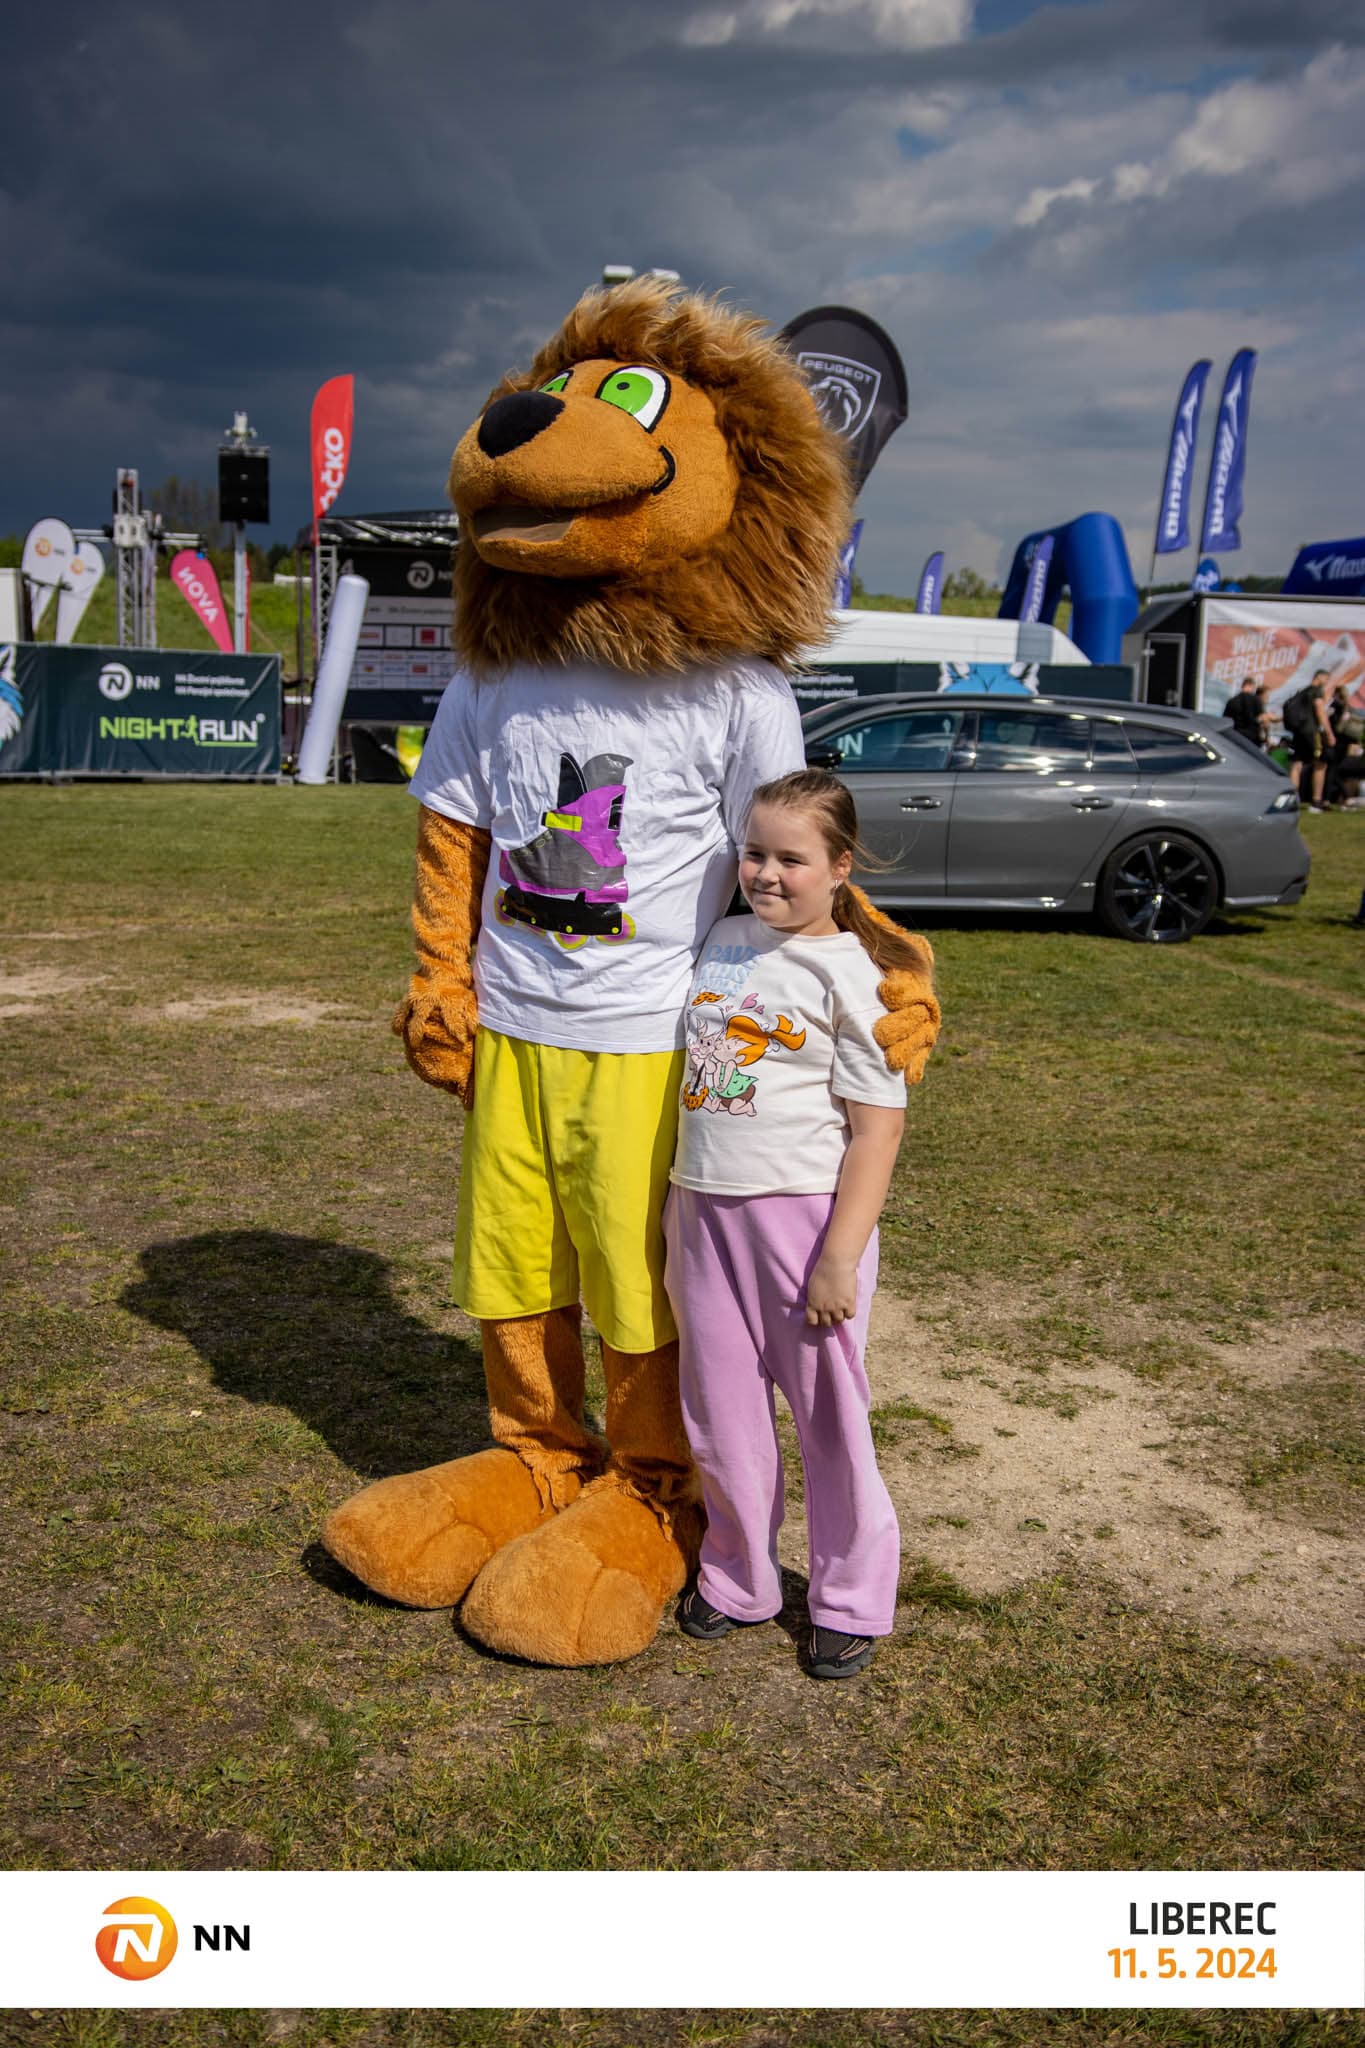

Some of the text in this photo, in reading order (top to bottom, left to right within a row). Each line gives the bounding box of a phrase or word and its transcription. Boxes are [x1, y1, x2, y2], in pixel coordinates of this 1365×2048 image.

[804, 360, 873, 384] PEUGEOT
[1233, 628, 1278, 655] WAVE
[1212, 646, 1300, 680] REBELLION
[136, 675, 160, 690] NN
[99, 716, 258, 742] NIGHT RUN
